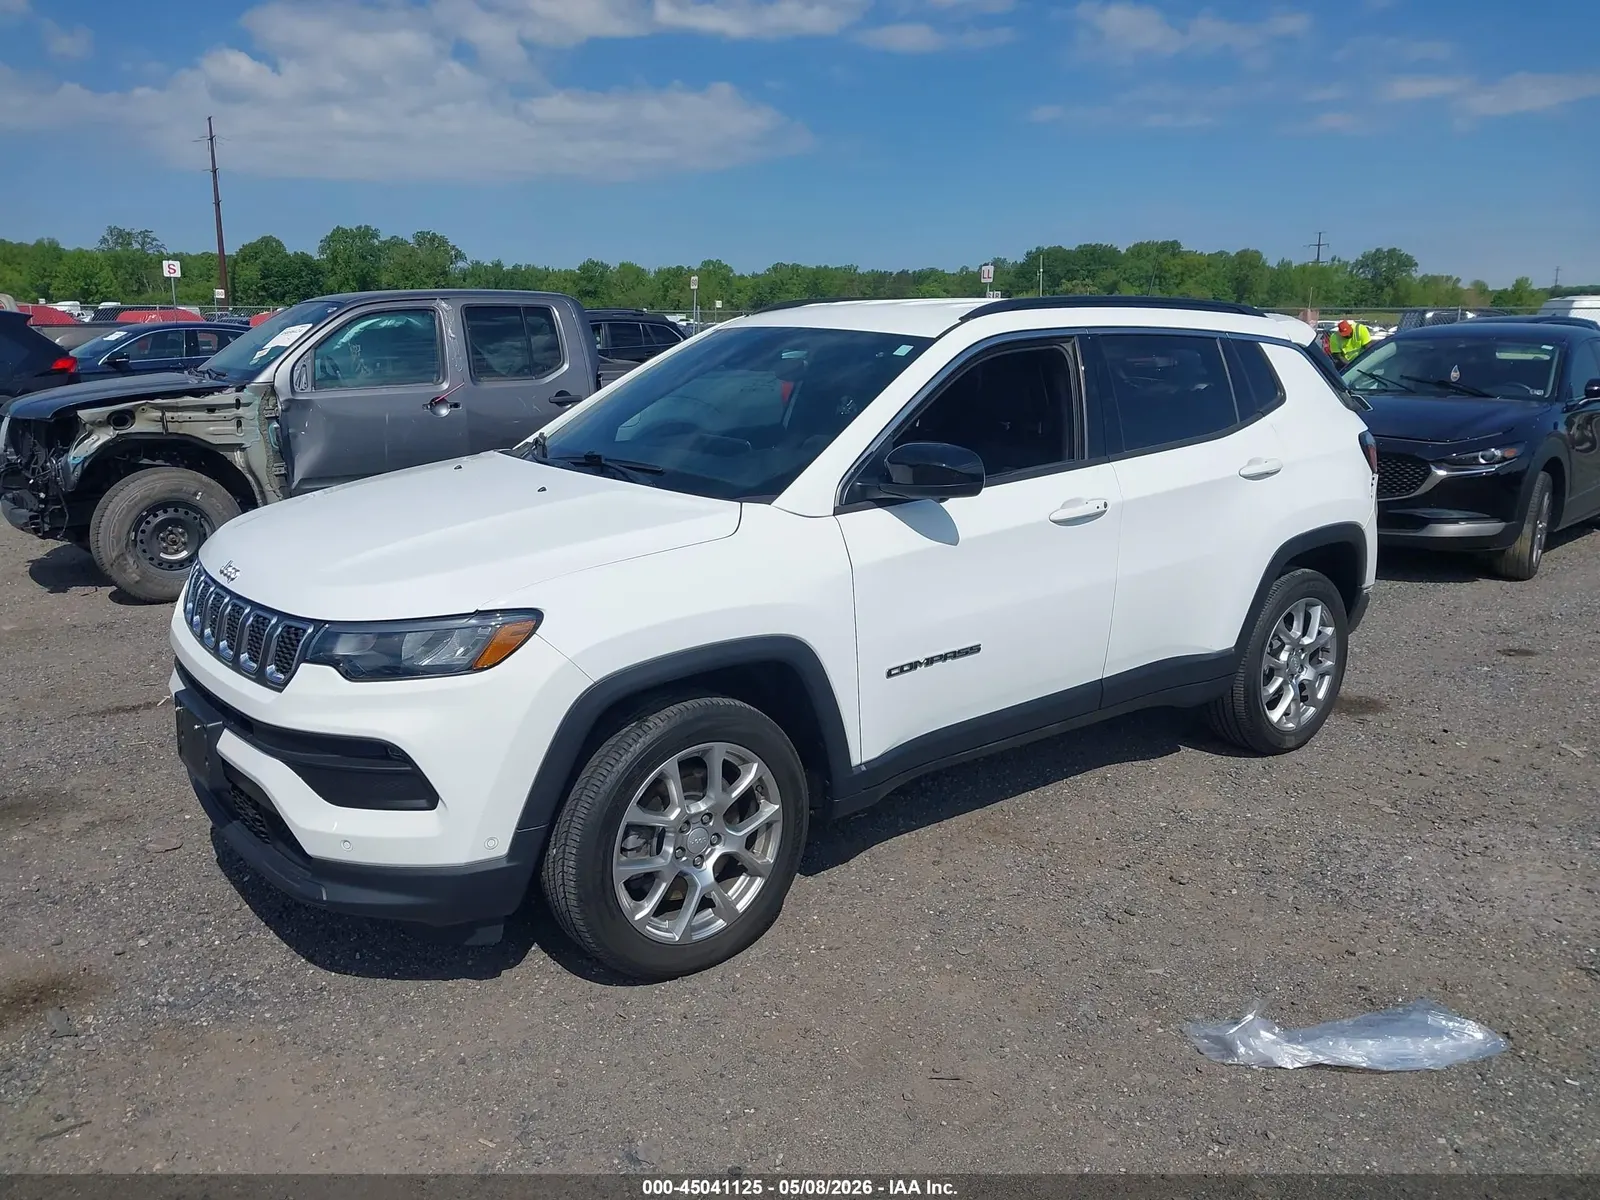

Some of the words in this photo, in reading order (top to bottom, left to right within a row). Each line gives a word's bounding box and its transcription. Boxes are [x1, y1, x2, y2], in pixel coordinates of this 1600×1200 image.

[167, 263, 177, 275] S
[982, 268, 992, 280] LL
[886, 643, 982, 679] COMPASS
